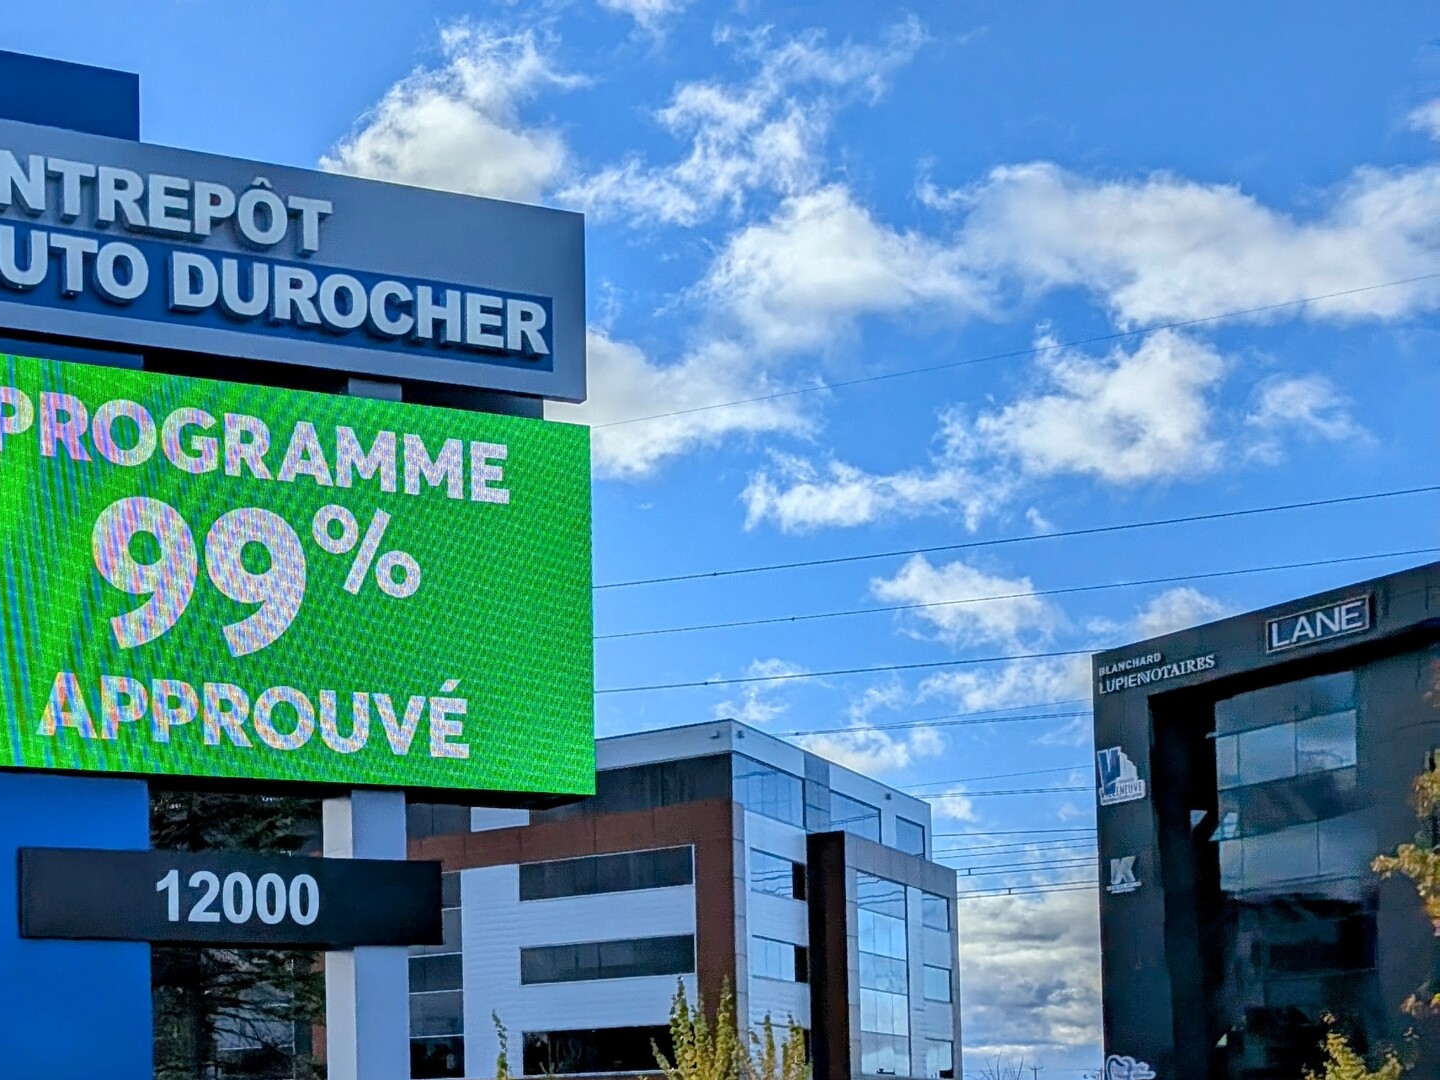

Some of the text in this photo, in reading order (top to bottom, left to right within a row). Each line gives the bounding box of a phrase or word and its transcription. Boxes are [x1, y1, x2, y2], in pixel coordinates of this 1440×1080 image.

[168, 250, 551, 358] DUROCHER
[91, 496, 422, 658] 99%
[1271, 600, 1364, 648] LANE
[1098, 653, 1162, 677] BLANCHARD
[36, 671, 471, 759] APPROUVÉ
[155, 868, 321, 927] 12000
